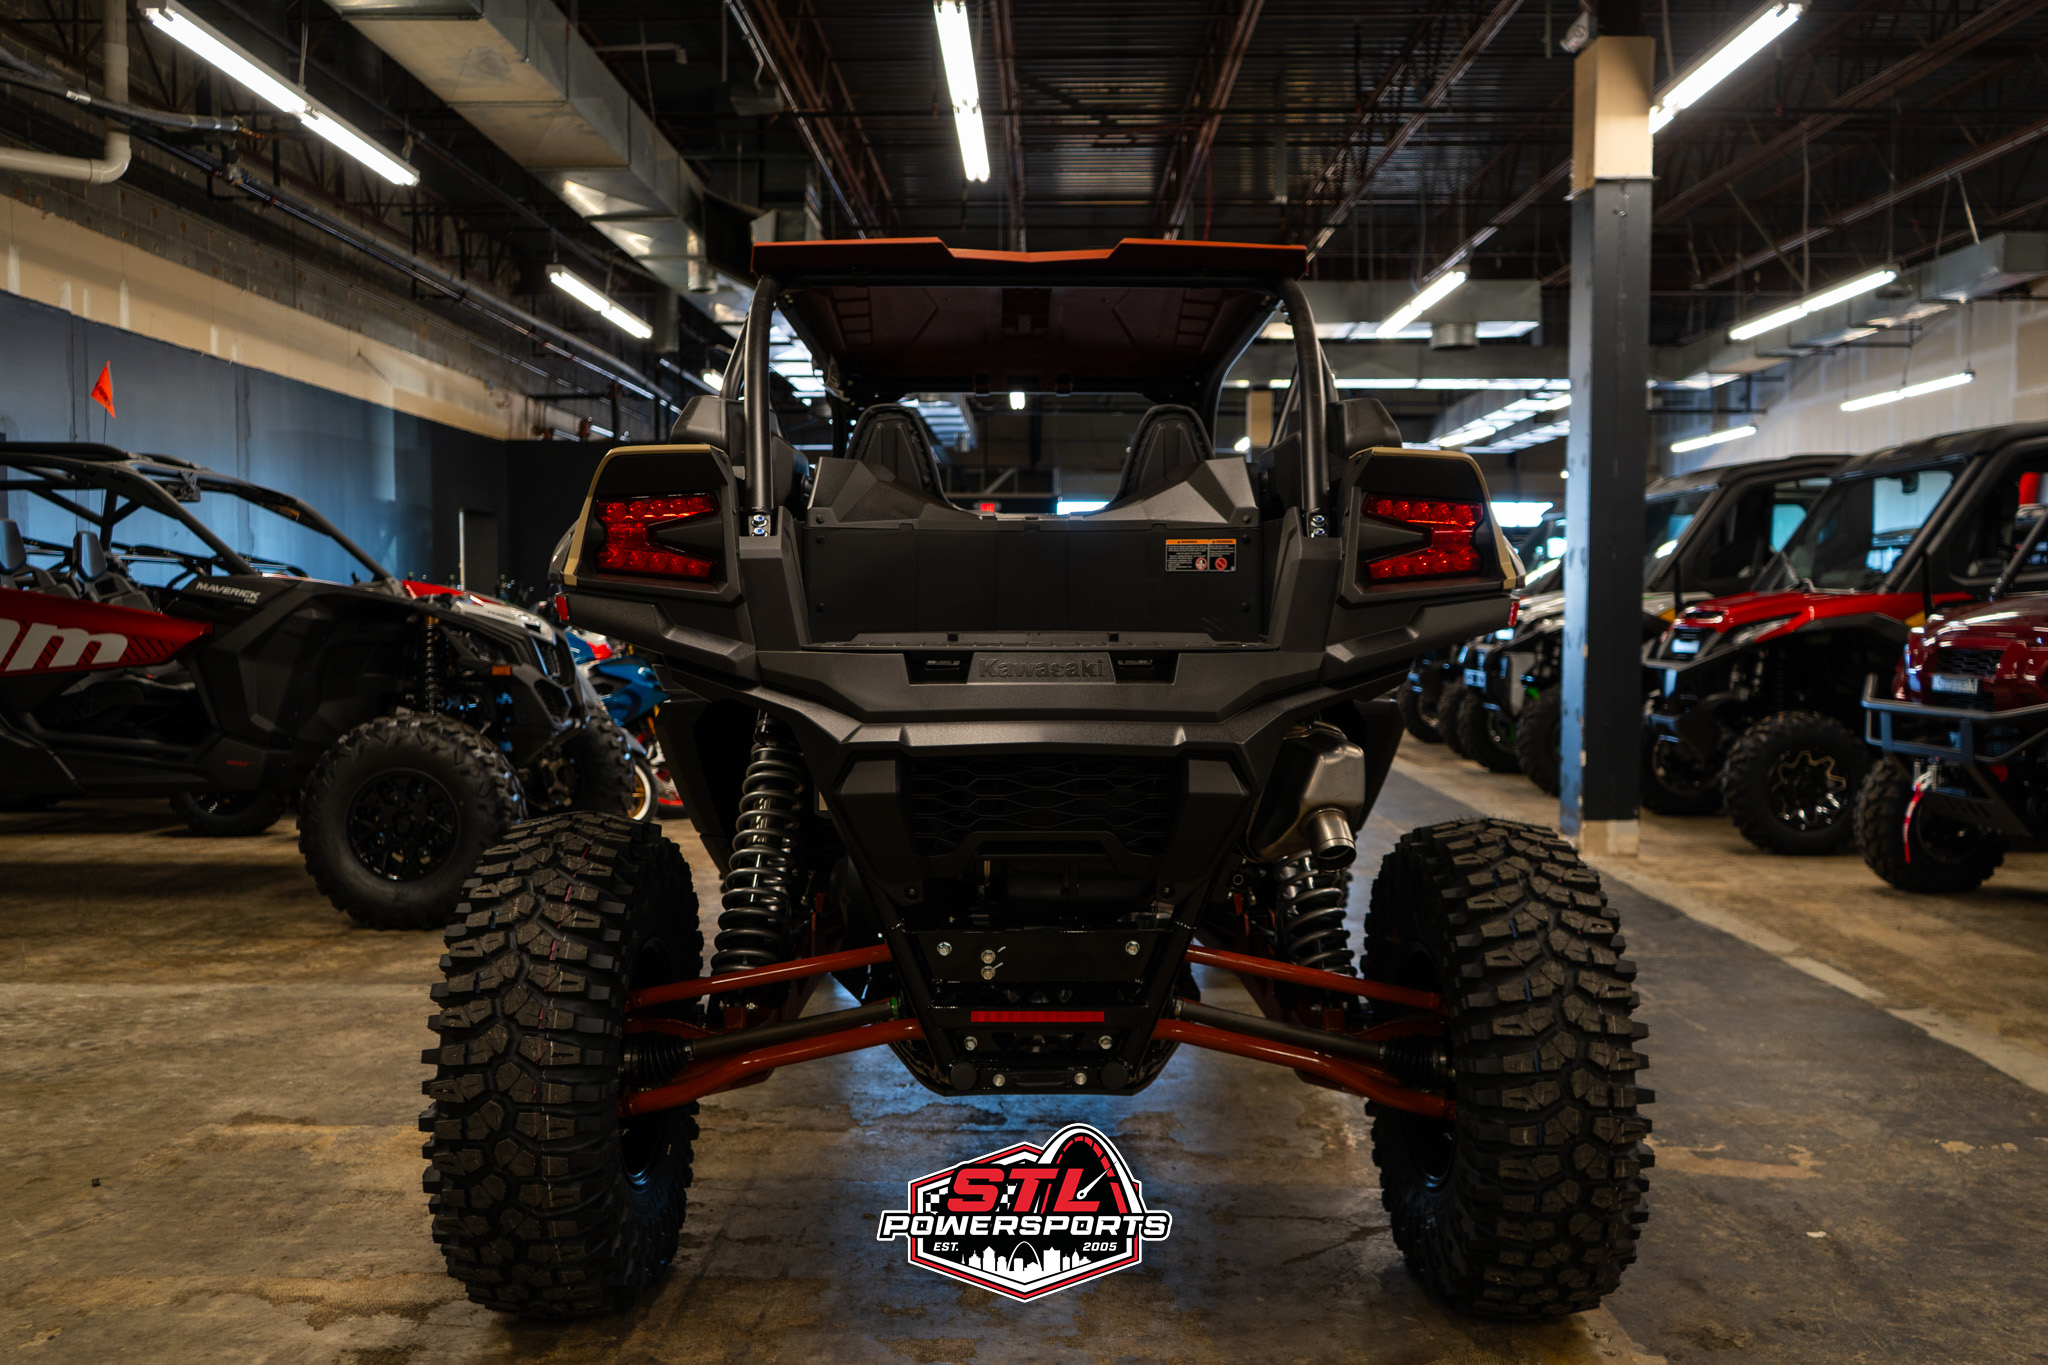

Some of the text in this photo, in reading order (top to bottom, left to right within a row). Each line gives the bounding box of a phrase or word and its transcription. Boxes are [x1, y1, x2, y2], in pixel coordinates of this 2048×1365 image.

[196, 581, 261, 599] MAVERICK
[978, 658, 1104, 678] Kawasaki
[1931, 674, 1979, 694] Kawasaki
